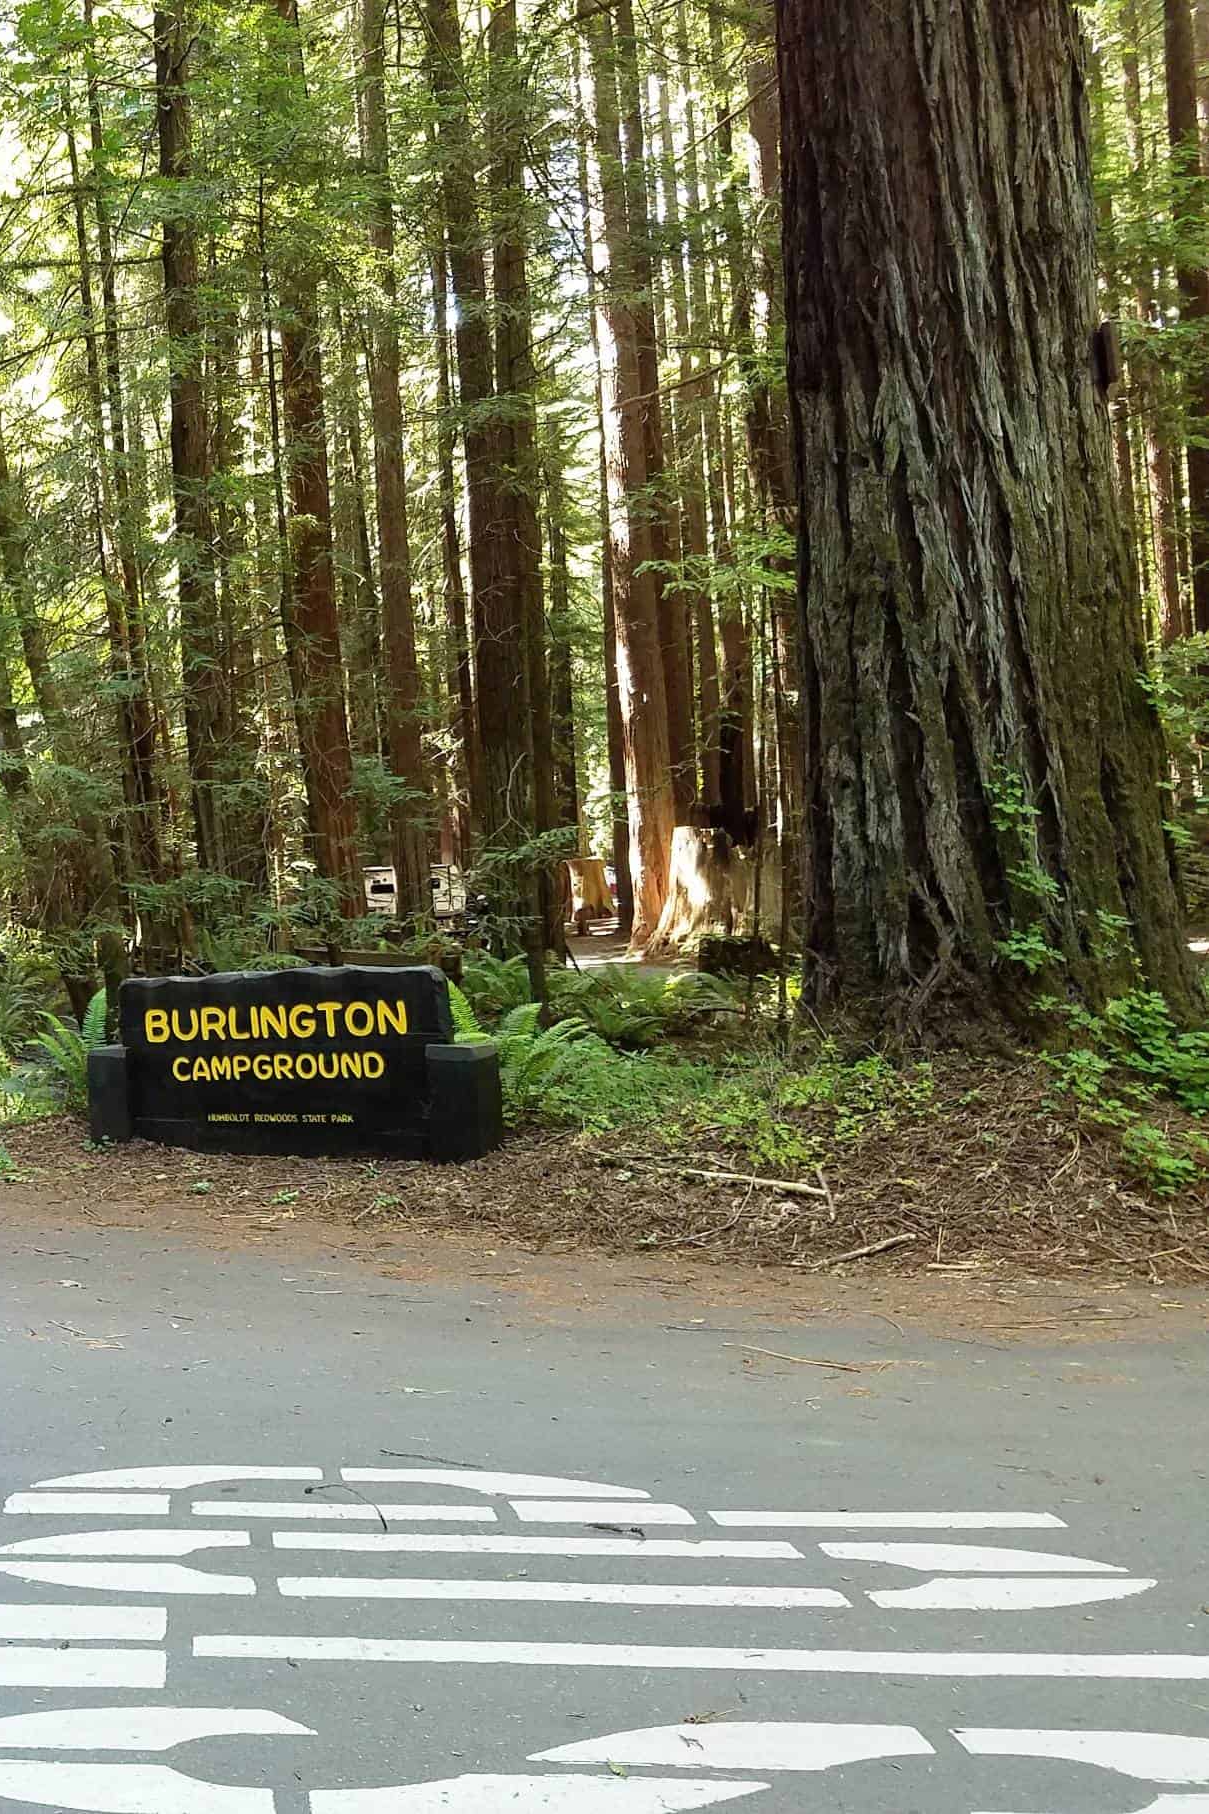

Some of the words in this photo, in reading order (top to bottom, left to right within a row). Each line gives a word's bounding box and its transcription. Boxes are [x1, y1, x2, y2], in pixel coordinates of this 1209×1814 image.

[144, 999, 408, 1044] BURLINGTON
[172, 1051, 385, 1082] CAMPGROUND
[207, 1113, 250, 1122] HUMBOLDT
[254, 1113, 298, 1123] REDWOODS
[302, 1114, 327, 1123] STATE
[331, 1114, 354, 1123] PARK
